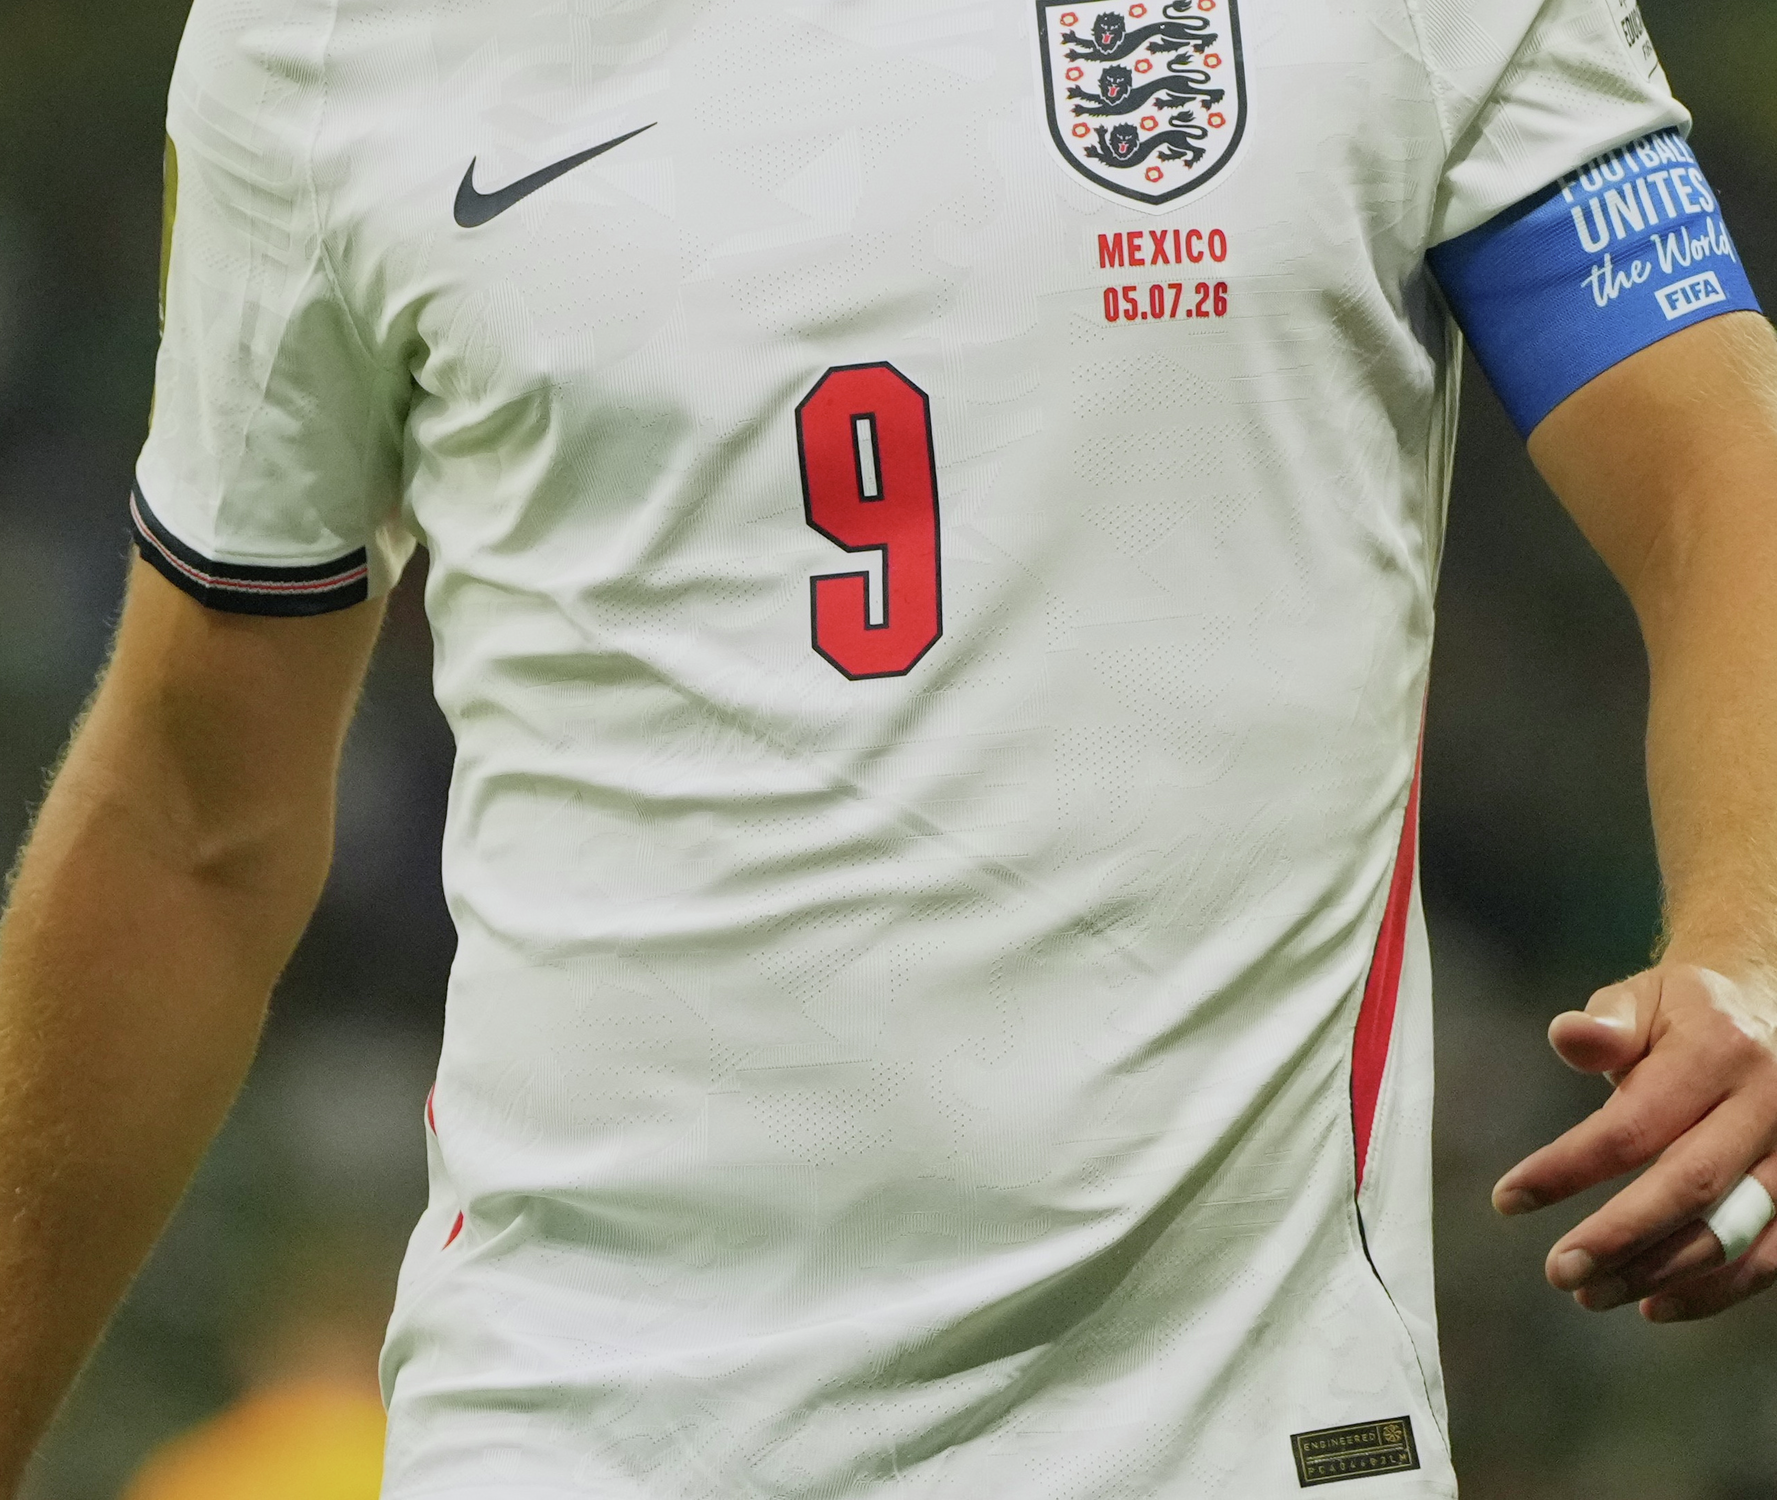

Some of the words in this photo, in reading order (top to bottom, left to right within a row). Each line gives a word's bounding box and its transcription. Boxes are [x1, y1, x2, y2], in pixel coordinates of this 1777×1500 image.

[1571, 167, 1715, 254] UNITES
[1098, 229, 1227, 268] MEXICO
[1581, 253, 1652, 307] the
[1651, 216, 1736, 274] World
[1103, 282, 1228, 322] 05.07.26
[1664, 278, 1720, 311] FIFA
[795, 361, 943, 681] 9
[1303, 1433, 1377, 1451] ENGINEERED
